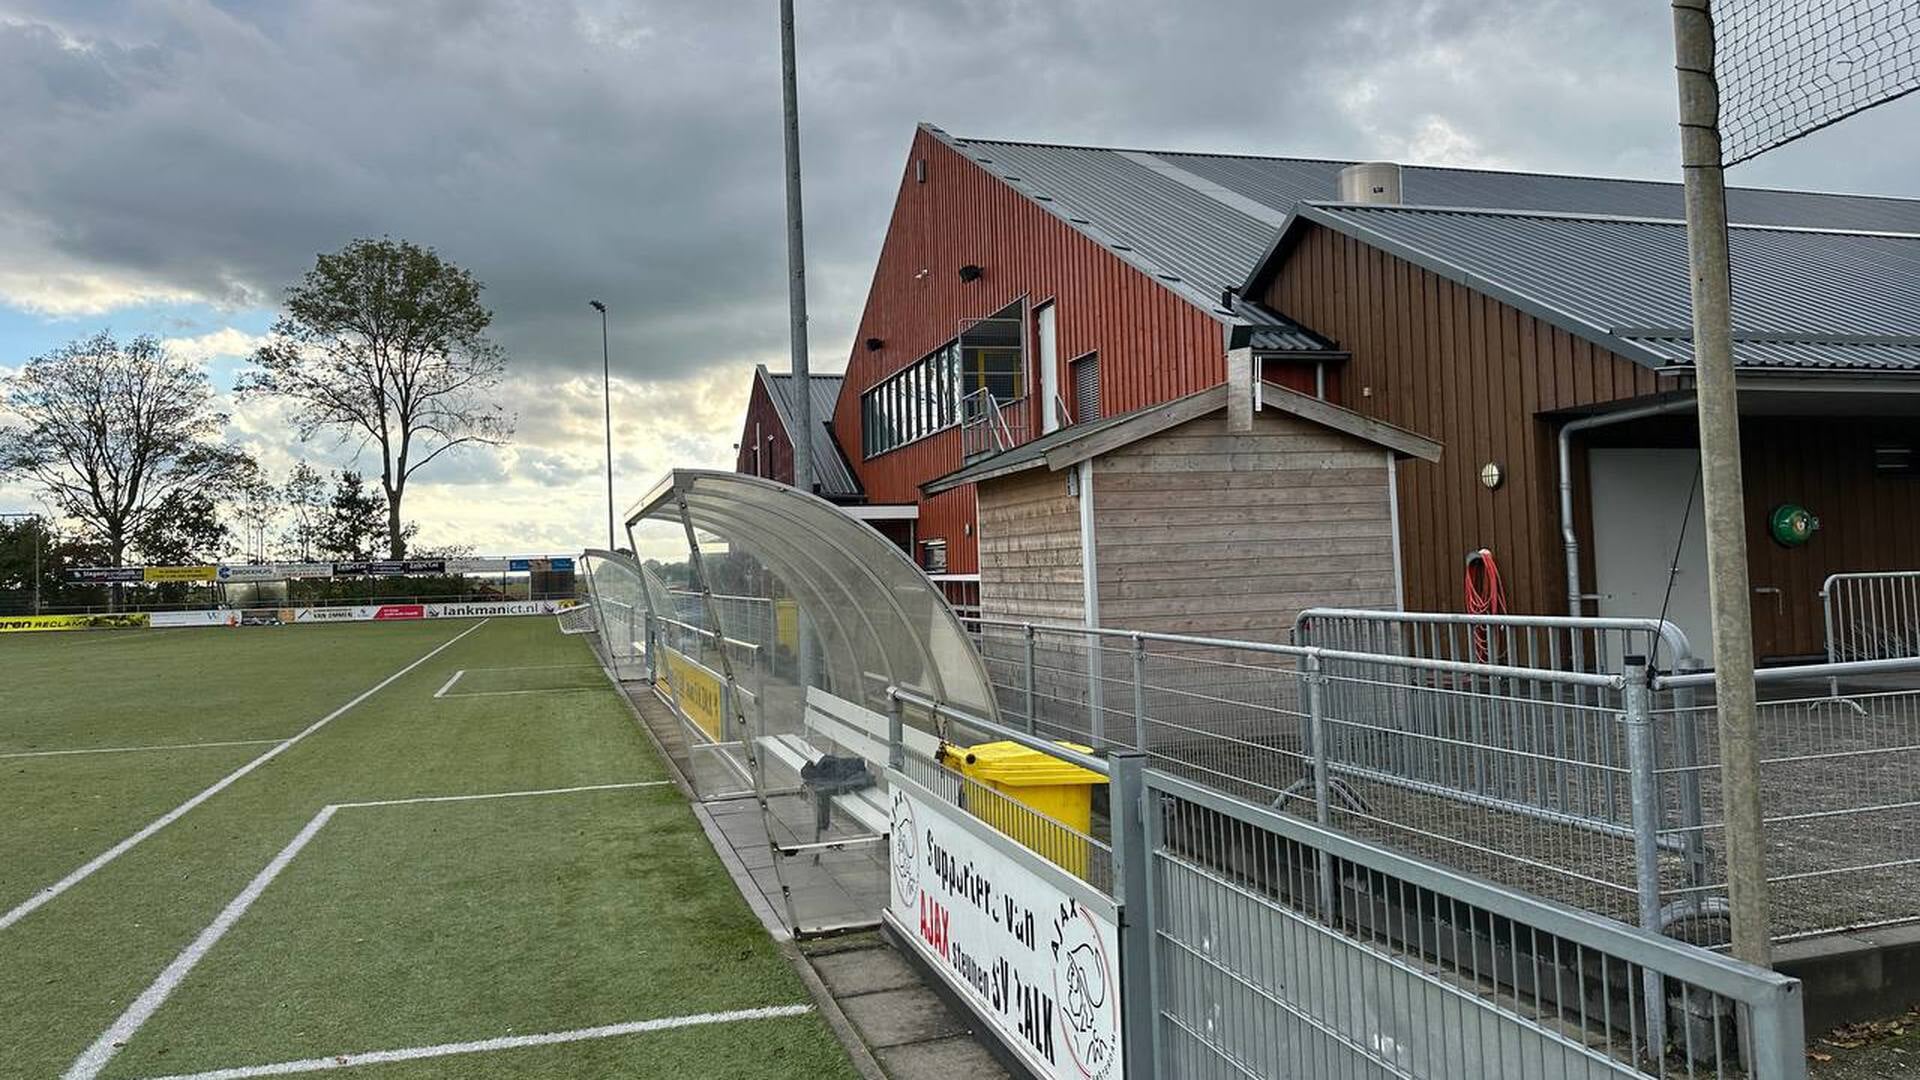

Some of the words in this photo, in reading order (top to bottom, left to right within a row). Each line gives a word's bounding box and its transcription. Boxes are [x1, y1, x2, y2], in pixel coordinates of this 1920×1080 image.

[443, 603, 538, 616] lankmanict.nl
[920, 889, 951, 962] AJAX
[952, 942, 990, 1001] steunen
[992, 956, 1009, 1015] SV
[1051, 897, 1078, 963] AJAX
